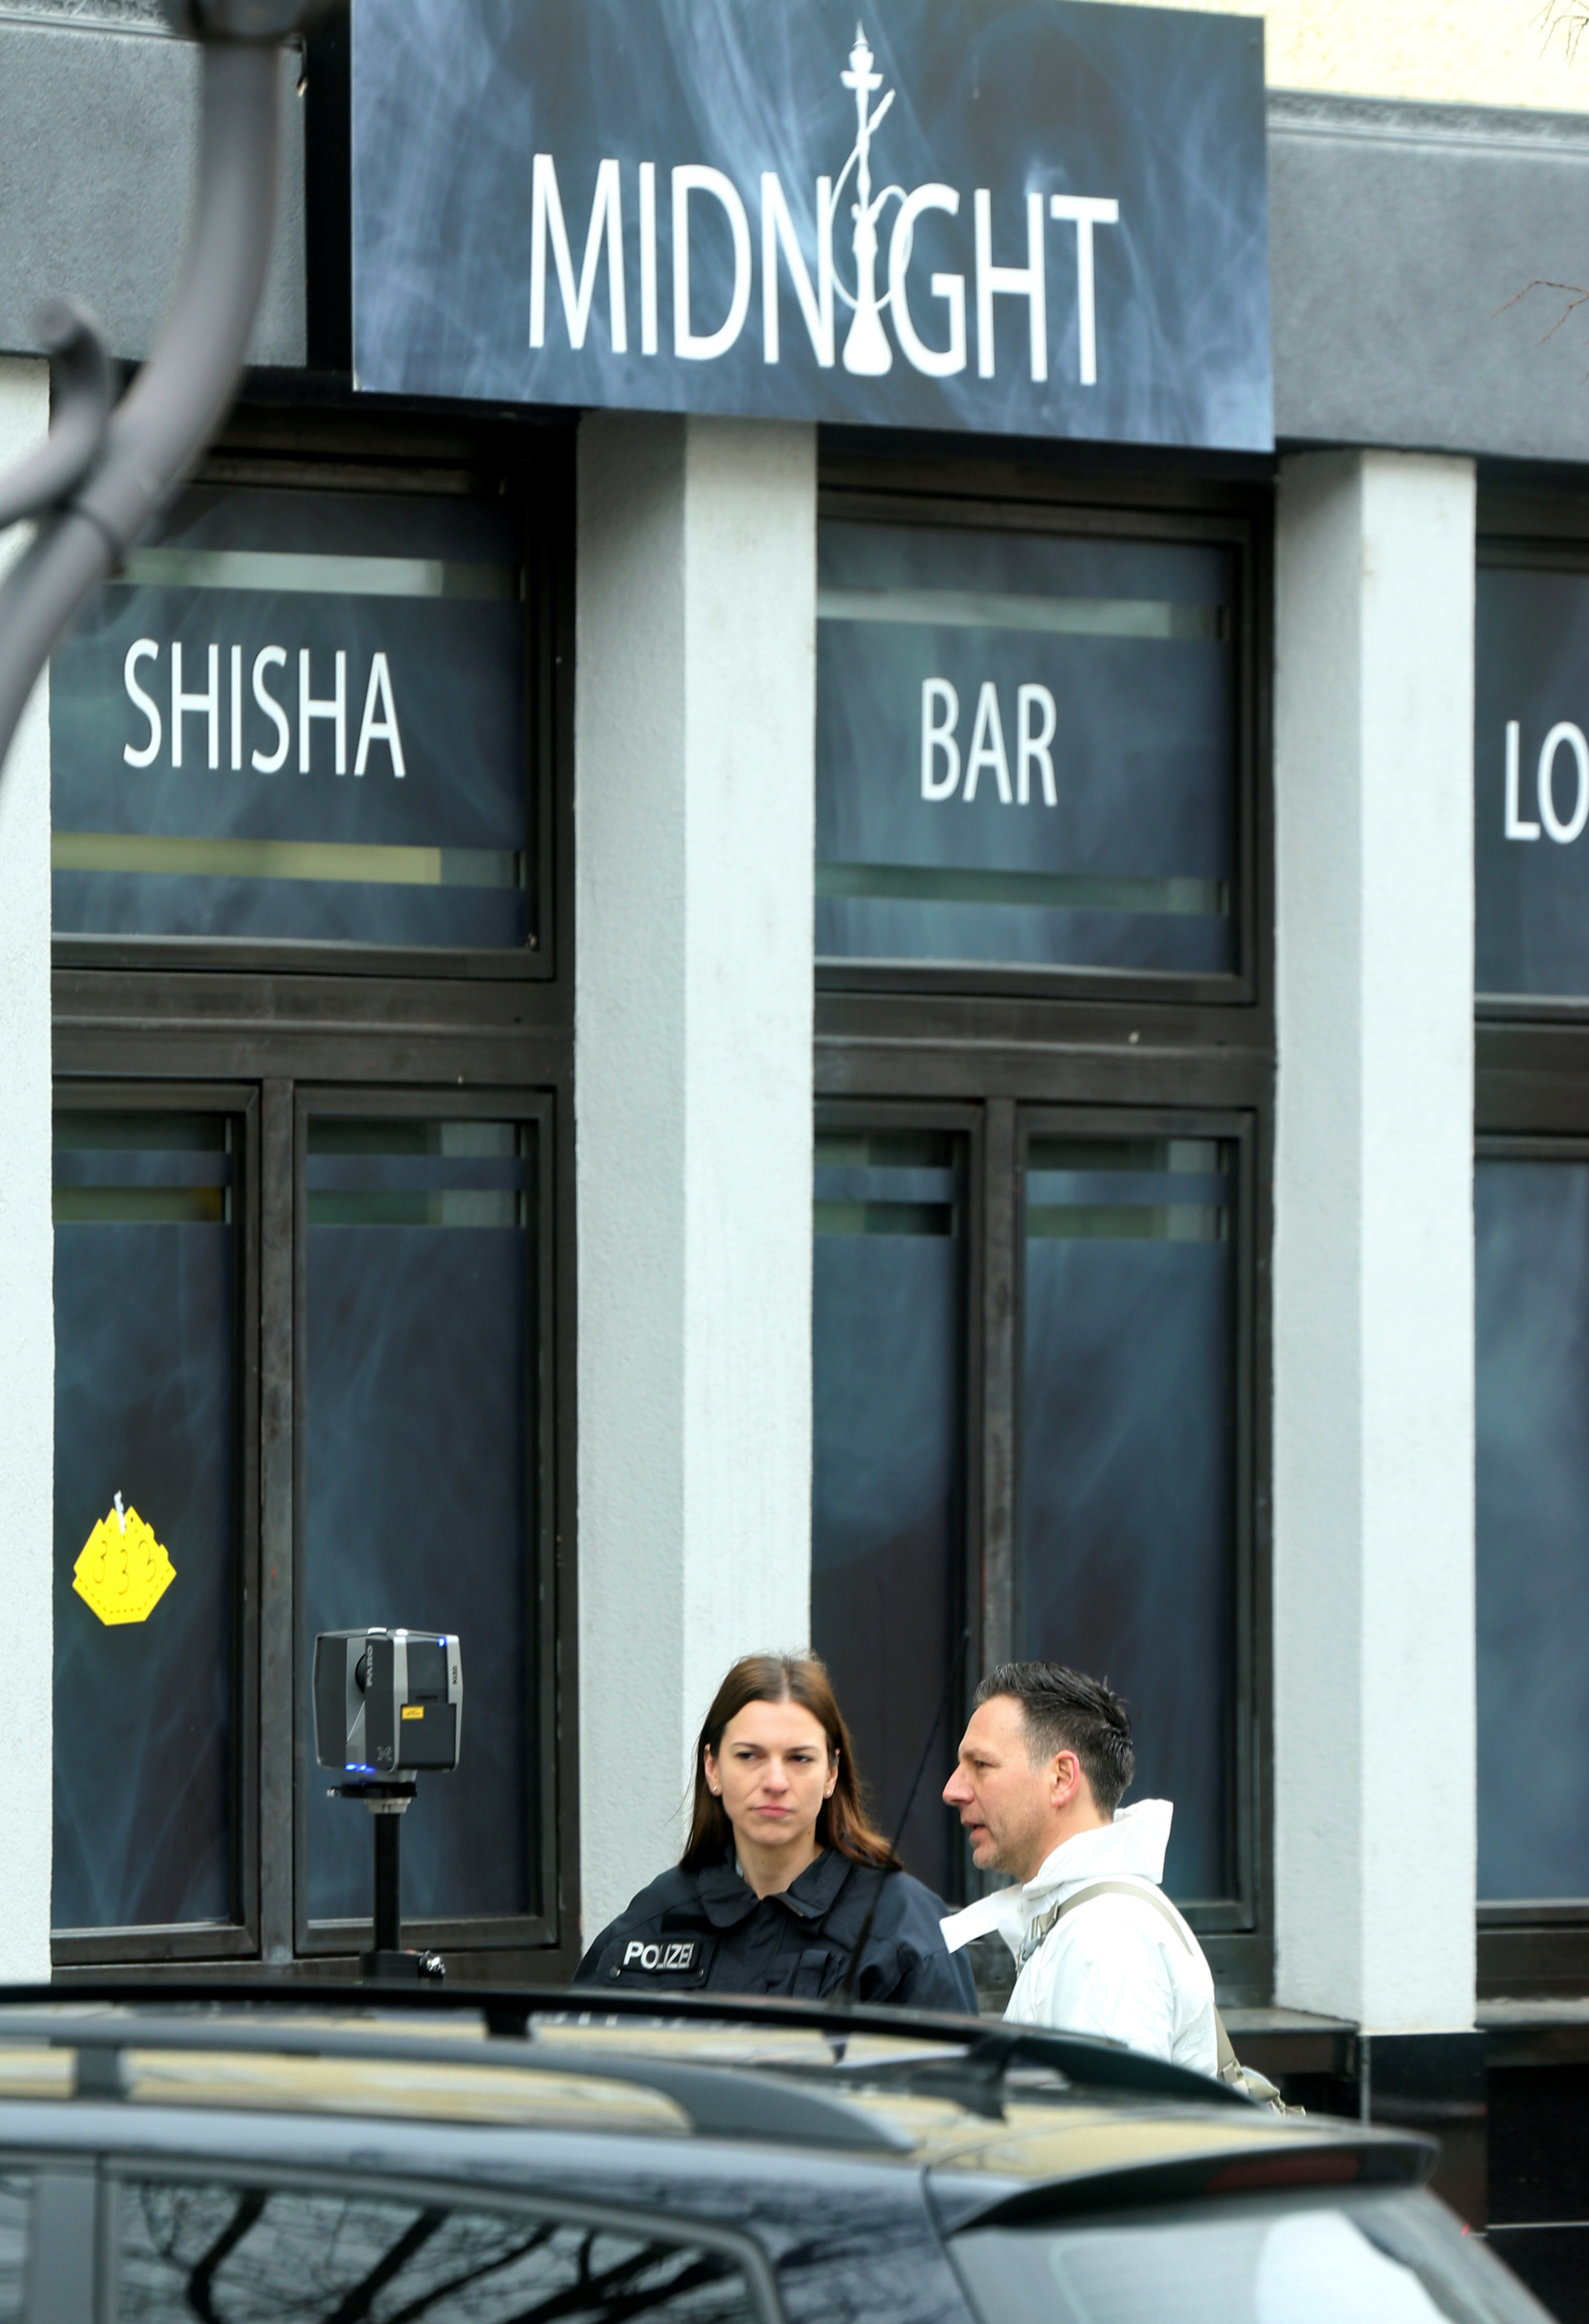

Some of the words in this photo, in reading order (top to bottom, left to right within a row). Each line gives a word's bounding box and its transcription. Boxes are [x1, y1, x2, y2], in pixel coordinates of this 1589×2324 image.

[123, 637, 406, 779] SHISHA
[921, 677, 1058, 808] BAR
[1504, 720, 1589, 844] LO
[623, 1940, 695, 1970] POLIZEI
